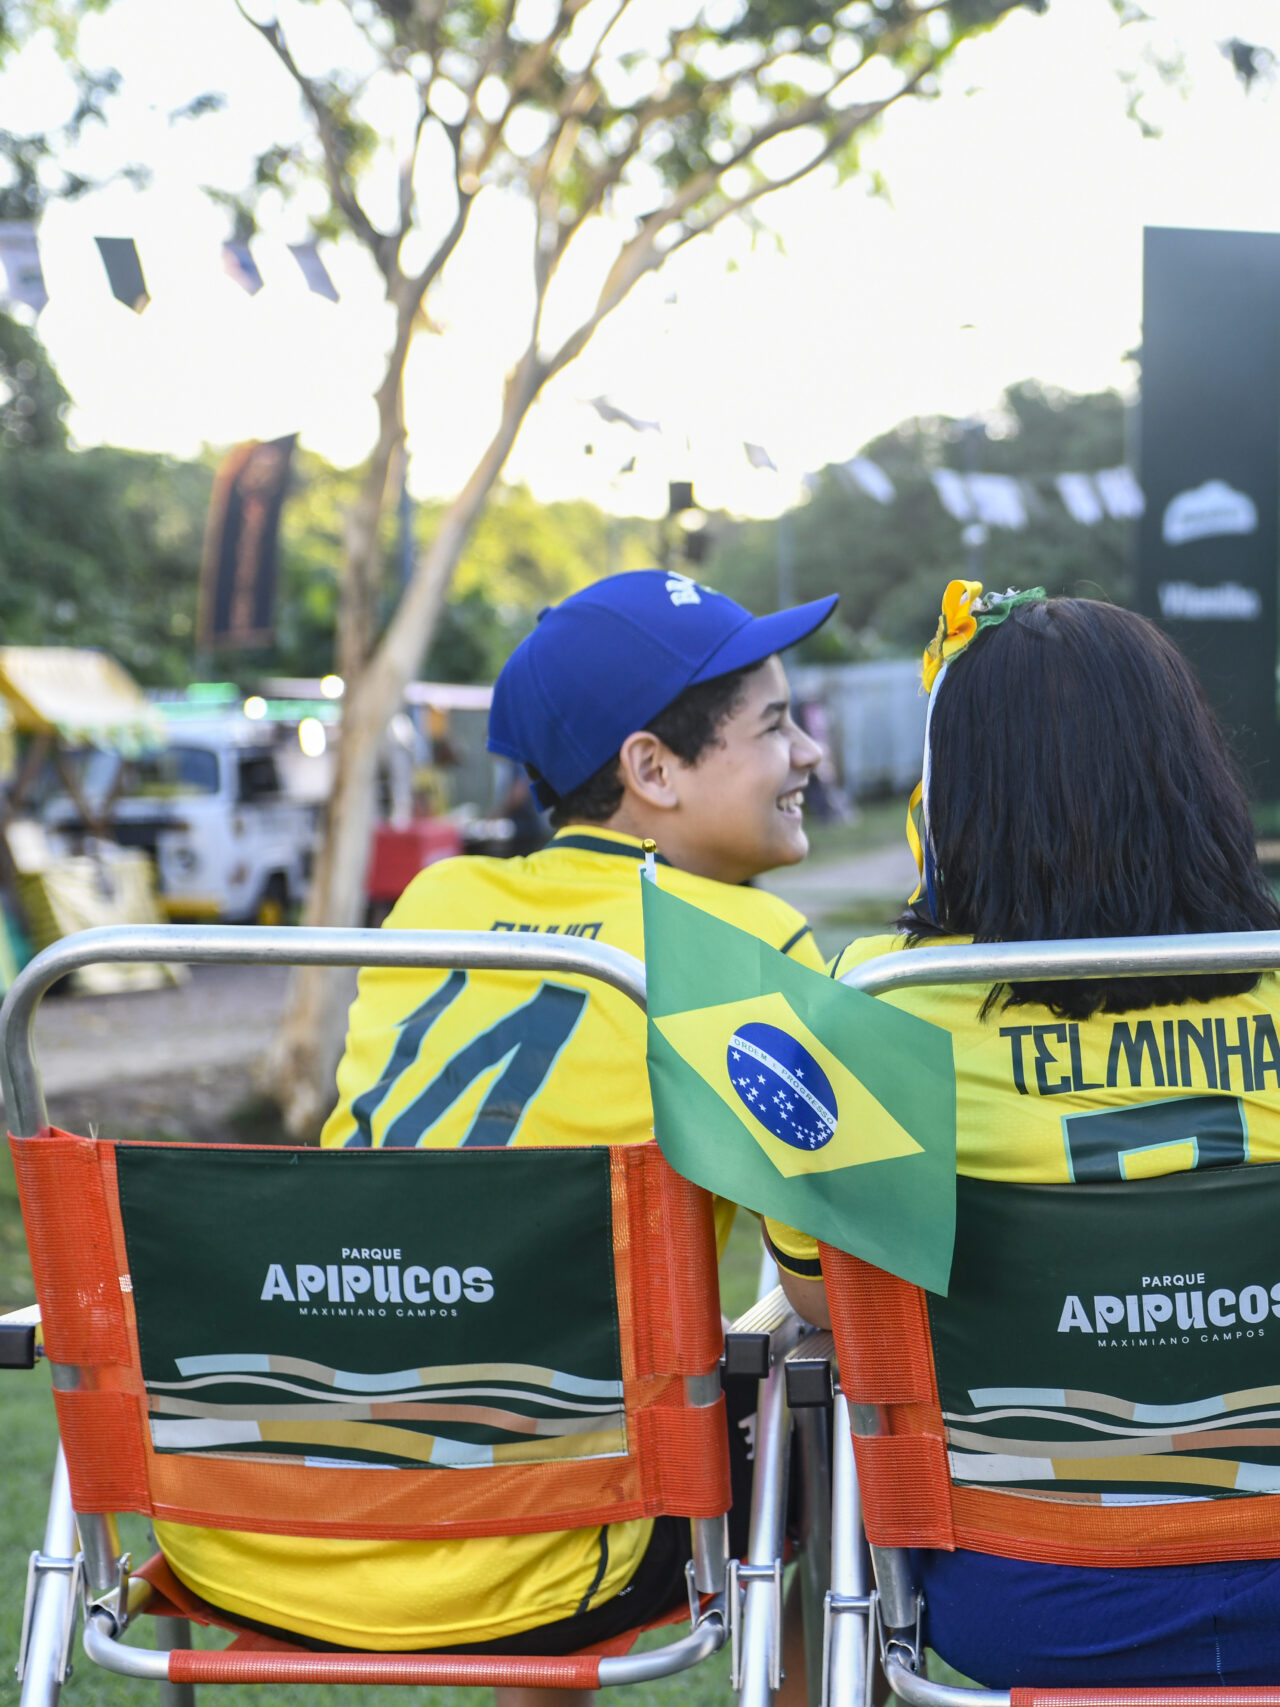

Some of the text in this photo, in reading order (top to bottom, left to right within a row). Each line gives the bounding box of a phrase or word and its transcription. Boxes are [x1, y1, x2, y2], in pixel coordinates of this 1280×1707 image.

[781, 1069, 835, 1125] PROGRESSO
[341, 1247, 402, 1261] PARQUE
[260, 1263, 495, 1304] APIPUCOS
[1142, 1272, 1206, 1288] PARQUE
[299, 1307, 459, 1318] MAXIMIANO CAMPOS
[1098, 1328, 1265, 1347] MAXIMIANO CAMPOS
